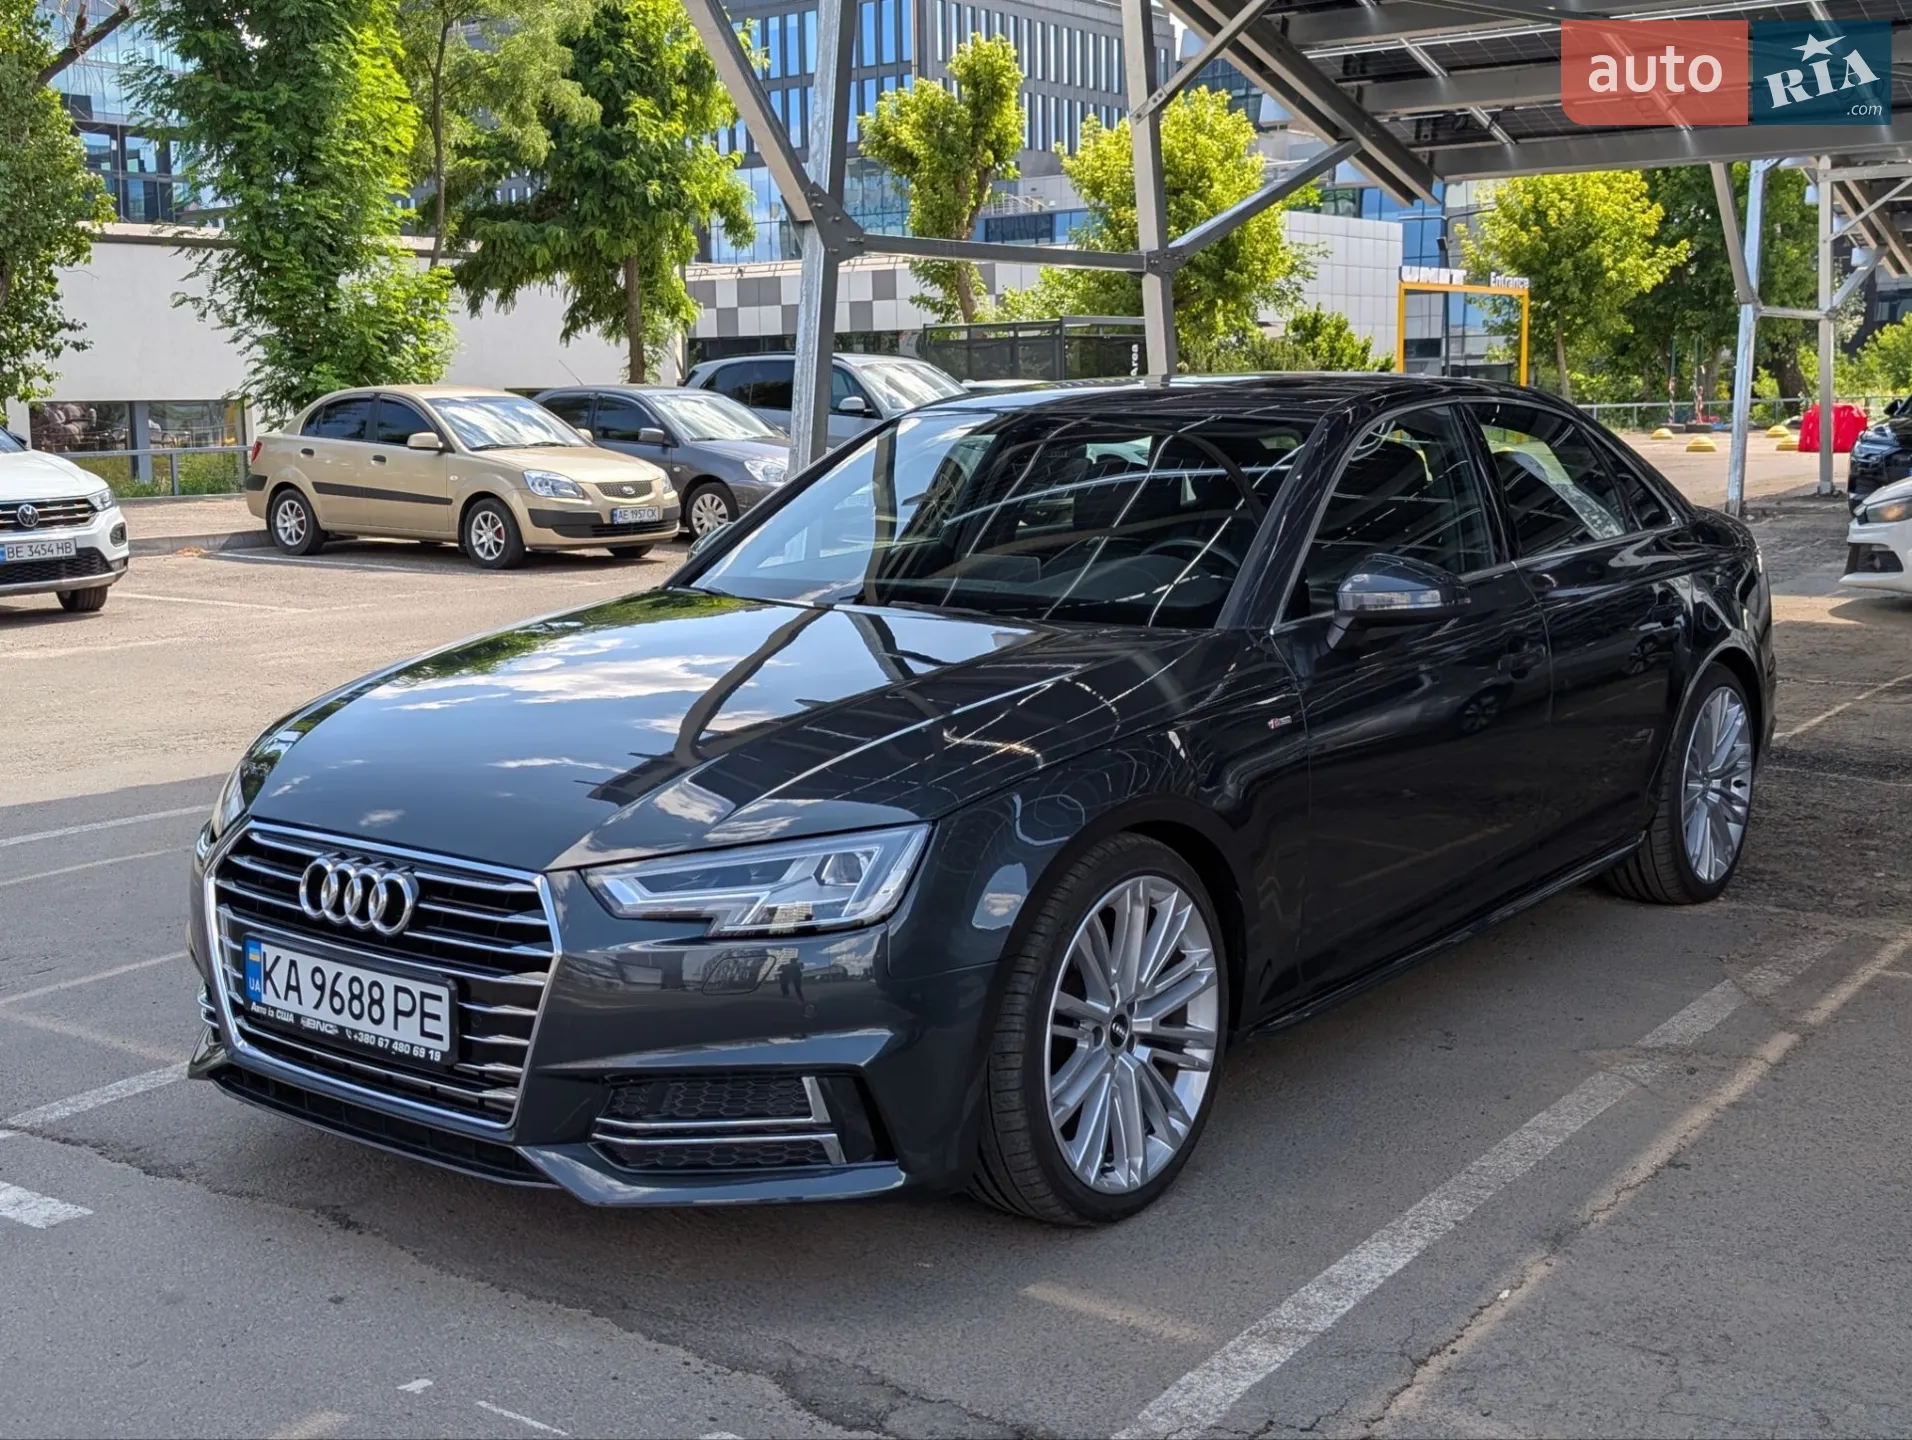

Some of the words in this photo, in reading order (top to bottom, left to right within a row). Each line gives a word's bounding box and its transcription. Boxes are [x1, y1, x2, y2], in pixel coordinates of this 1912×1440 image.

[1489, 271, 1530, 289] Entrance
[7, 545, 25, 559] BE
[28, 543, 54, 557] 3454
[56, 541, 73, 555] HB
[248, 977, 260, 992] UA
[262, 951, 304, 1006] KA
[311, 966, 385, 1026] 9688
[393, 984, 444, 1042] PE
[353, 1031, 375, 1046] +380
[377, 1036, 390, 1049] 67
[428, 1049, 442, 1062] 19
